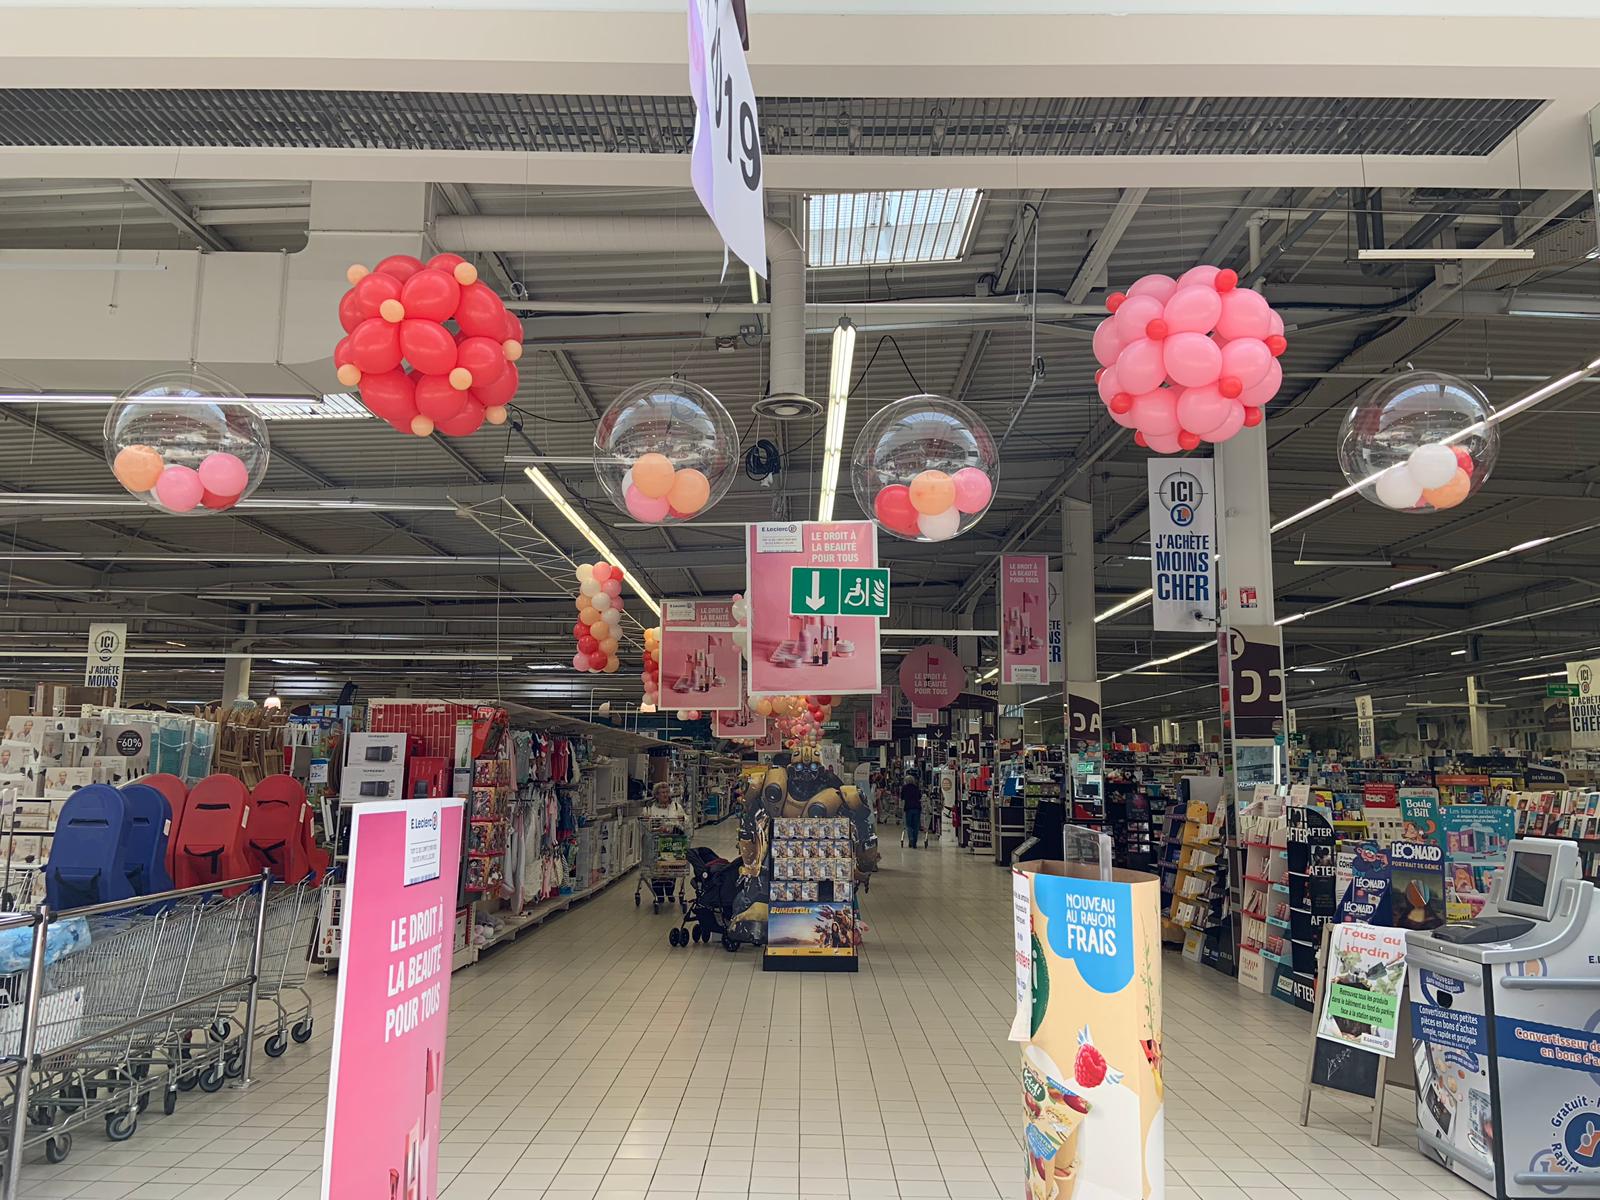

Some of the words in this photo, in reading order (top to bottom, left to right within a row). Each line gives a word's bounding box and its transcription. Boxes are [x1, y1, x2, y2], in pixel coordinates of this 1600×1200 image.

[1170, 481, 1193, 502] ICI
[811, 531, 821, 541] LE
[824, 531, 848, 541] DROIT
[850, 529, 857, 540] À
[1155, 530, 1210, 550] J'ACHÈTE
[824, 542, 857, 551] BEAUTÉ
[812, 554, 835, 562] POUR
[837, 554, 859, 562] TOUS
[1156, 551, 1209, 573] MOINS
[1157, 573, 1209, 601] CHER
[101, 637, 114, 648] ICI
[89, 664, 120, 675] J'ACHÈTE
[1580, 670, 1589, 681] ICI
[88, 676, 118, 687] MOINS
[1571, 694, 1600, 706] J'ACHÈT
[1572, 717, 1600, 732] CHE
[117, 737, 141, 748] -60%
[1406, 799, 1432, 809] Boule
[1413, 808, 1429, 818] Bill
[1286, 827, 1308, 843] AFTER
[1307, 827, 1332, 837] AFTER
[1392, 842, 1442, 861] LÉONARD
[1309, 865, 1337, 877] AFTER
[1355, 877, 1386, 889] LÉONARD
[1065, 893, 1116, 914] NOUVEAU
[1343, 901, 1374, 914] LÉONARD
[390, 916, 407, 953] LE
[409, 905, 438, 946] DROIT
[438, 896, 444, 932] À
[1066, 909, 1078, 923] AU
[1080, 912, 1116, 928] RAYON
[1311, 915, 1333, 926] AFTE
[1066, 924, 1117, 957] FRAIS
[1343, 927, 1376, 941] Tous
[1383, 936, 1401, 946] au
[1343, 943, 1389, 960] jardin
[387, 960, 405, 997] LA
[407, 935, 442, 989] BEAUTÉ
[1293, 981, 1315, 1003] AFTER
[1426, 976, 1435, 984] dans
[1444, 983, 1461, 992] magasin
[1339, 987, 1358, 999] Retrouvez
[1372, 997, 1389, 1006] produits
[384, 996, 419, 1043] POUR
[420, 981, 441, 1022] TOUS
[1331, 996, 1341, 1004] dans
[1345, 999, 1361, 1009] bâtiment
[1367, 1004, 1376, 1012] fond
[1380, 1008, 1395, 1019] parking
[1340, 1007, 1349, 1015] face
[1356, 1012, 1369, 1020] station
[1419, 1005, 1449, 1019] Convertissez
[1450, 1012, 1459, 1020] vos
[1459, 1013, 1478, 1025] petites
[1421, 1016, 1436, 1026] pièces
[1442, 1020, 1455, 1031] bons
[1455, 1024, 1478, 1036] d'achats
[1423, 1026, 1438, 1037] simple,
[1437, 1030, 1451, 1041] rapide
[1457, 1035, 1477, 1046] pratique
[1515, 1027, 1588, 1050] Convertisseur
[1541, 1046, 1555, 1058] en
[1556, 1047, 1583, 1064] bons
[1551, 1095, 1588, 1128] Gratuit
